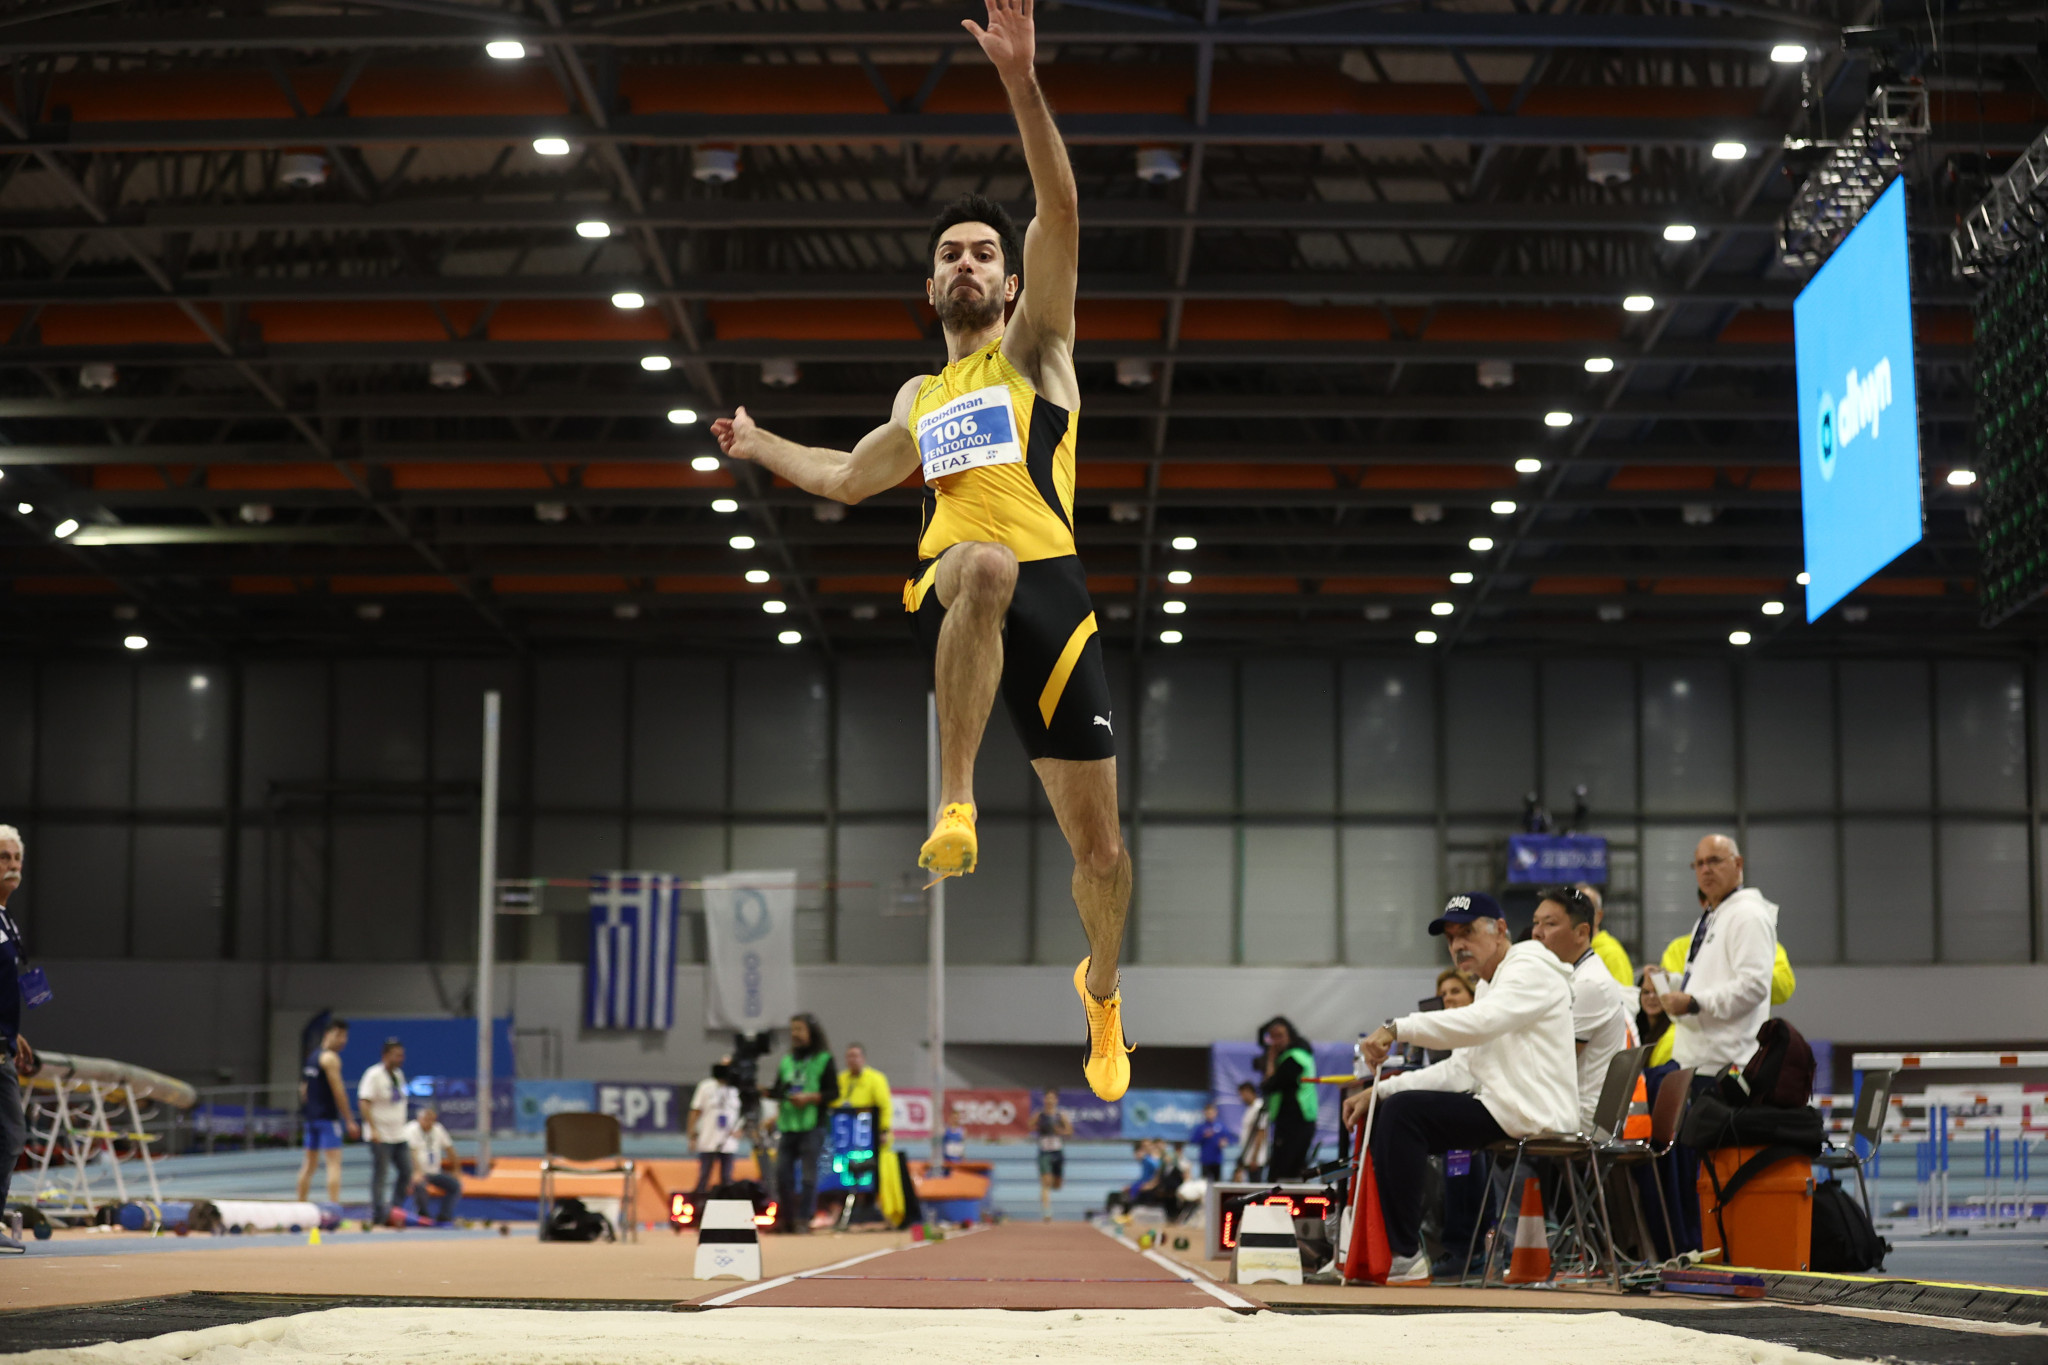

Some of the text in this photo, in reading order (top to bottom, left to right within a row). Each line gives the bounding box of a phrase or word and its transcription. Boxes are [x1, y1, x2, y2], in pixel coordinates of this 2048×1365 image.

[920, 397, 983, 431] Stoiximan
[1837, 355, 1893, 448] allwyn
[932, 415, 978, 445] 106
